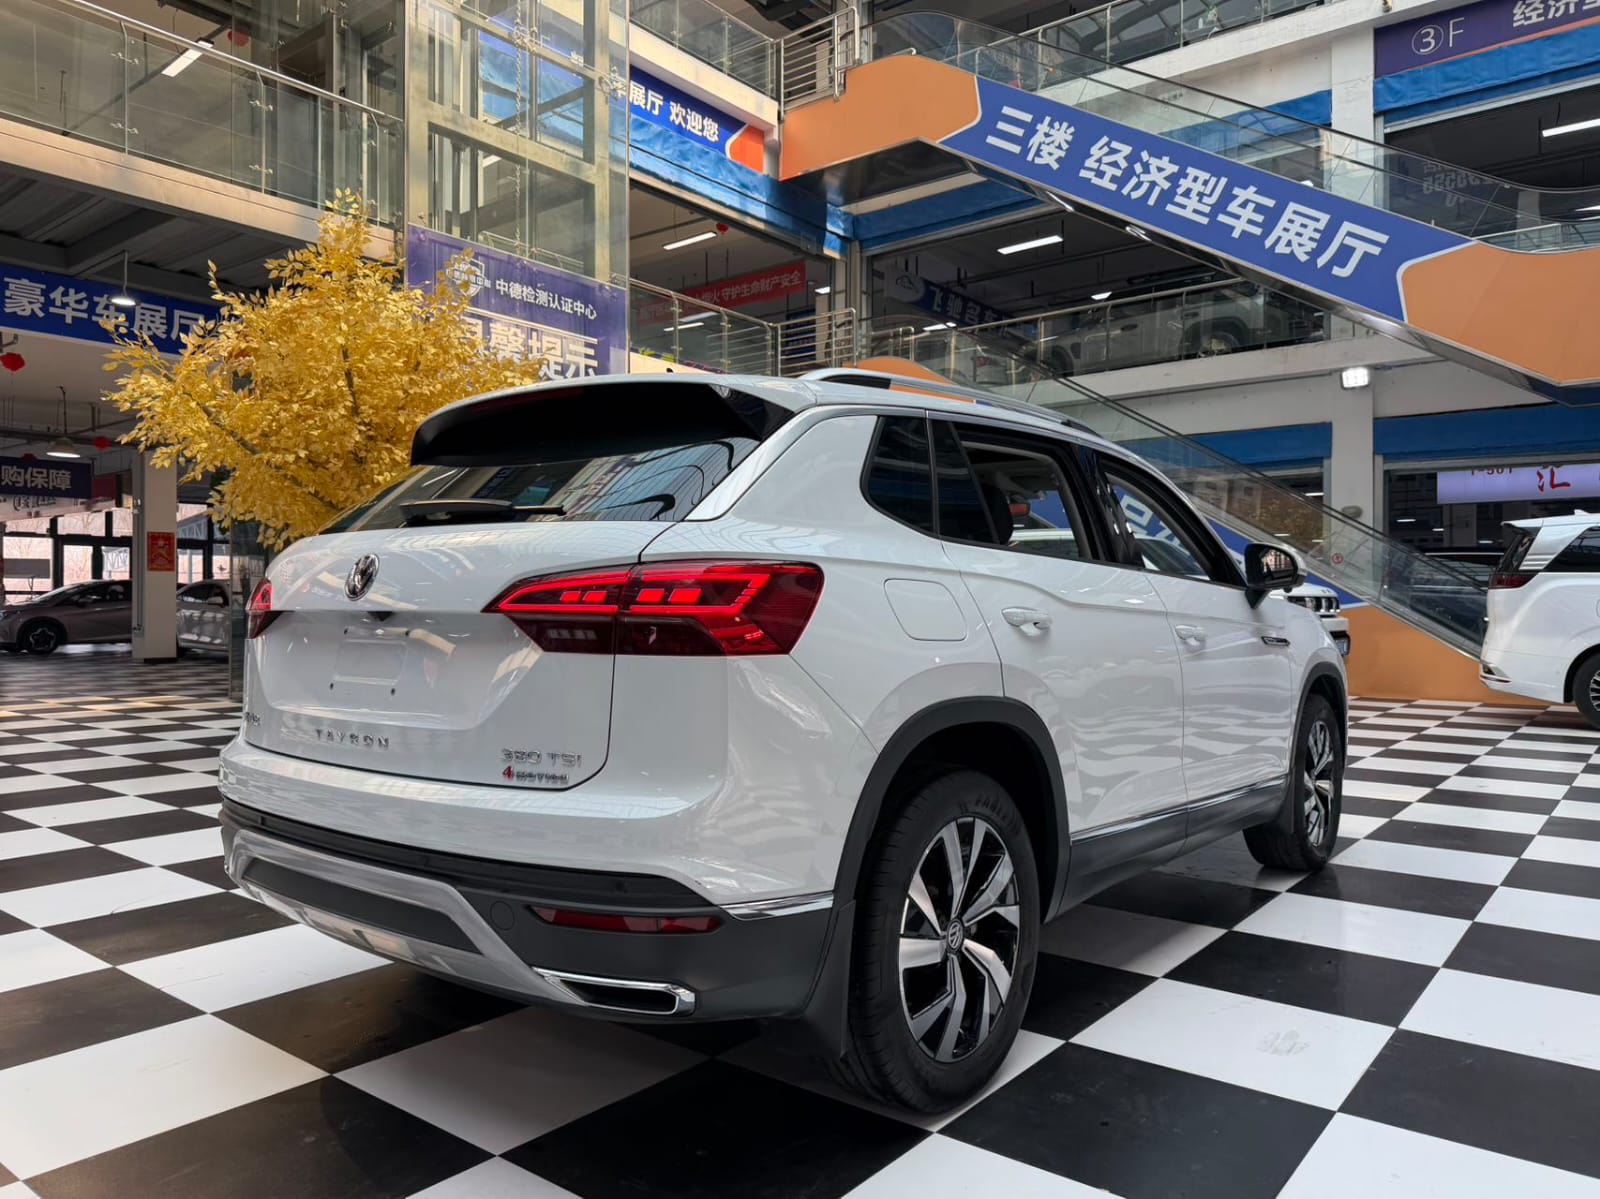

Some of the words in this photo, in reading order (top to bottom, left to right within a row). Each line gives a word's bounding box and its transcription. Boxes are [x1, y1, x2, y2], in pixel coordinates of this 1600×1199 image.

[669, 101, 719, 142] 欢迎您
[986, 105, 1075, 170] 三楼
[1079, 135, 1390, 278] 经济型车展厅
[4, 277, 206, 342] 豪华车展厅
[495, 278, 598, 320] 中德检测认证中心
[1, 465, 72, 491] 购保障
[315, 728, 390, 750] TAYRON
[547, 752, 582, 767] TSI
